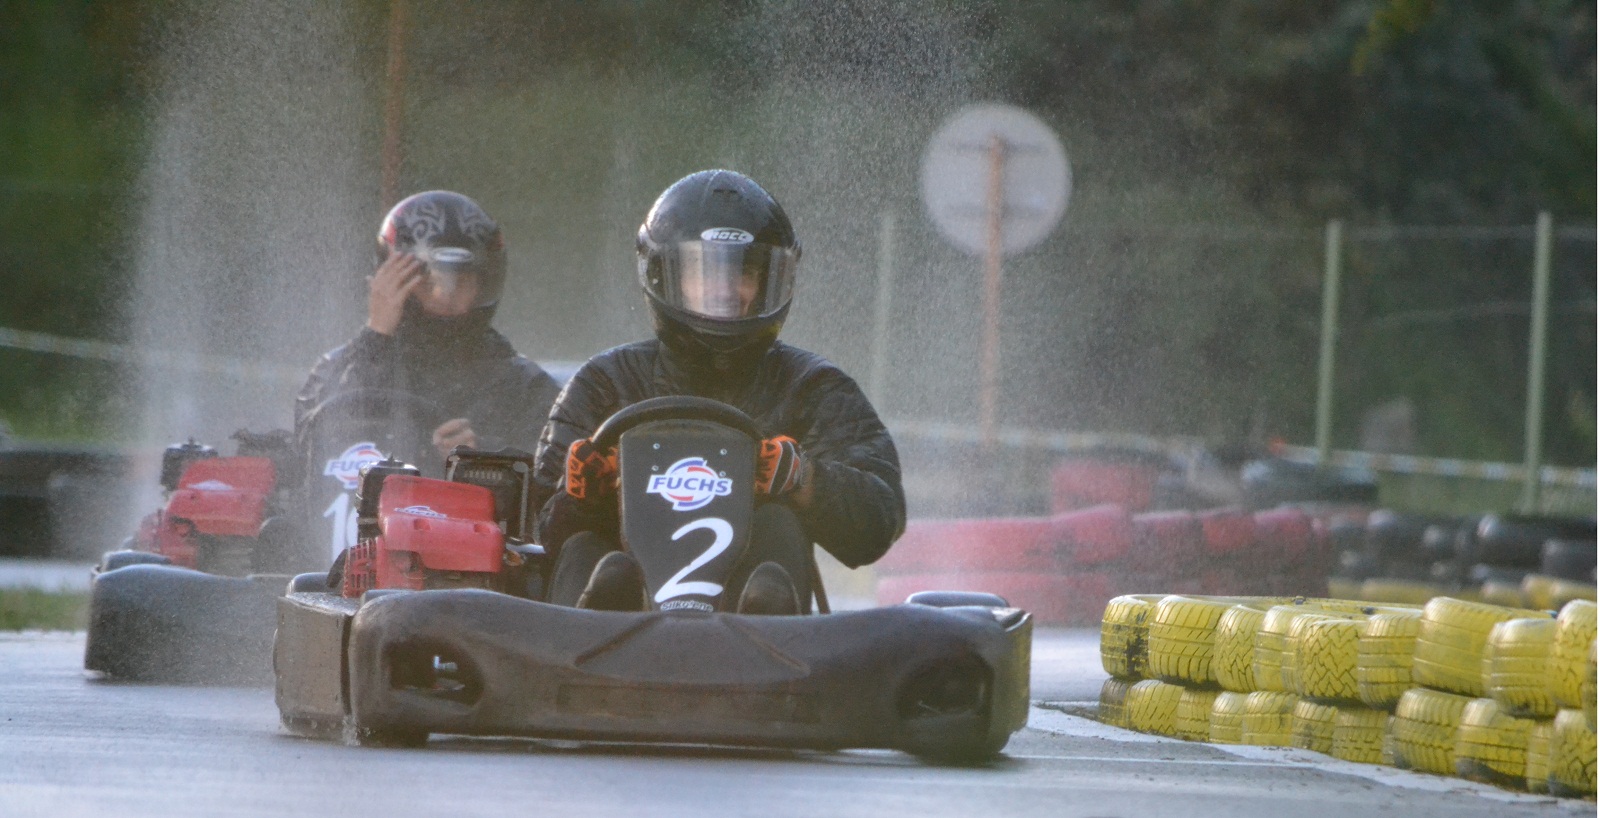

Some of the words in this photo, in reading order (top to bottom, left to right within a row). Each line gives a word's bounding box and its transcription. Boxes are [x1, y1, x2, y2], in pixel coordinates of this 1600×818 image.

[330, 460, 370, 472] FUC
[653, 477, 729, 493] FUCHS
[654, 517, 734, 603] 2
